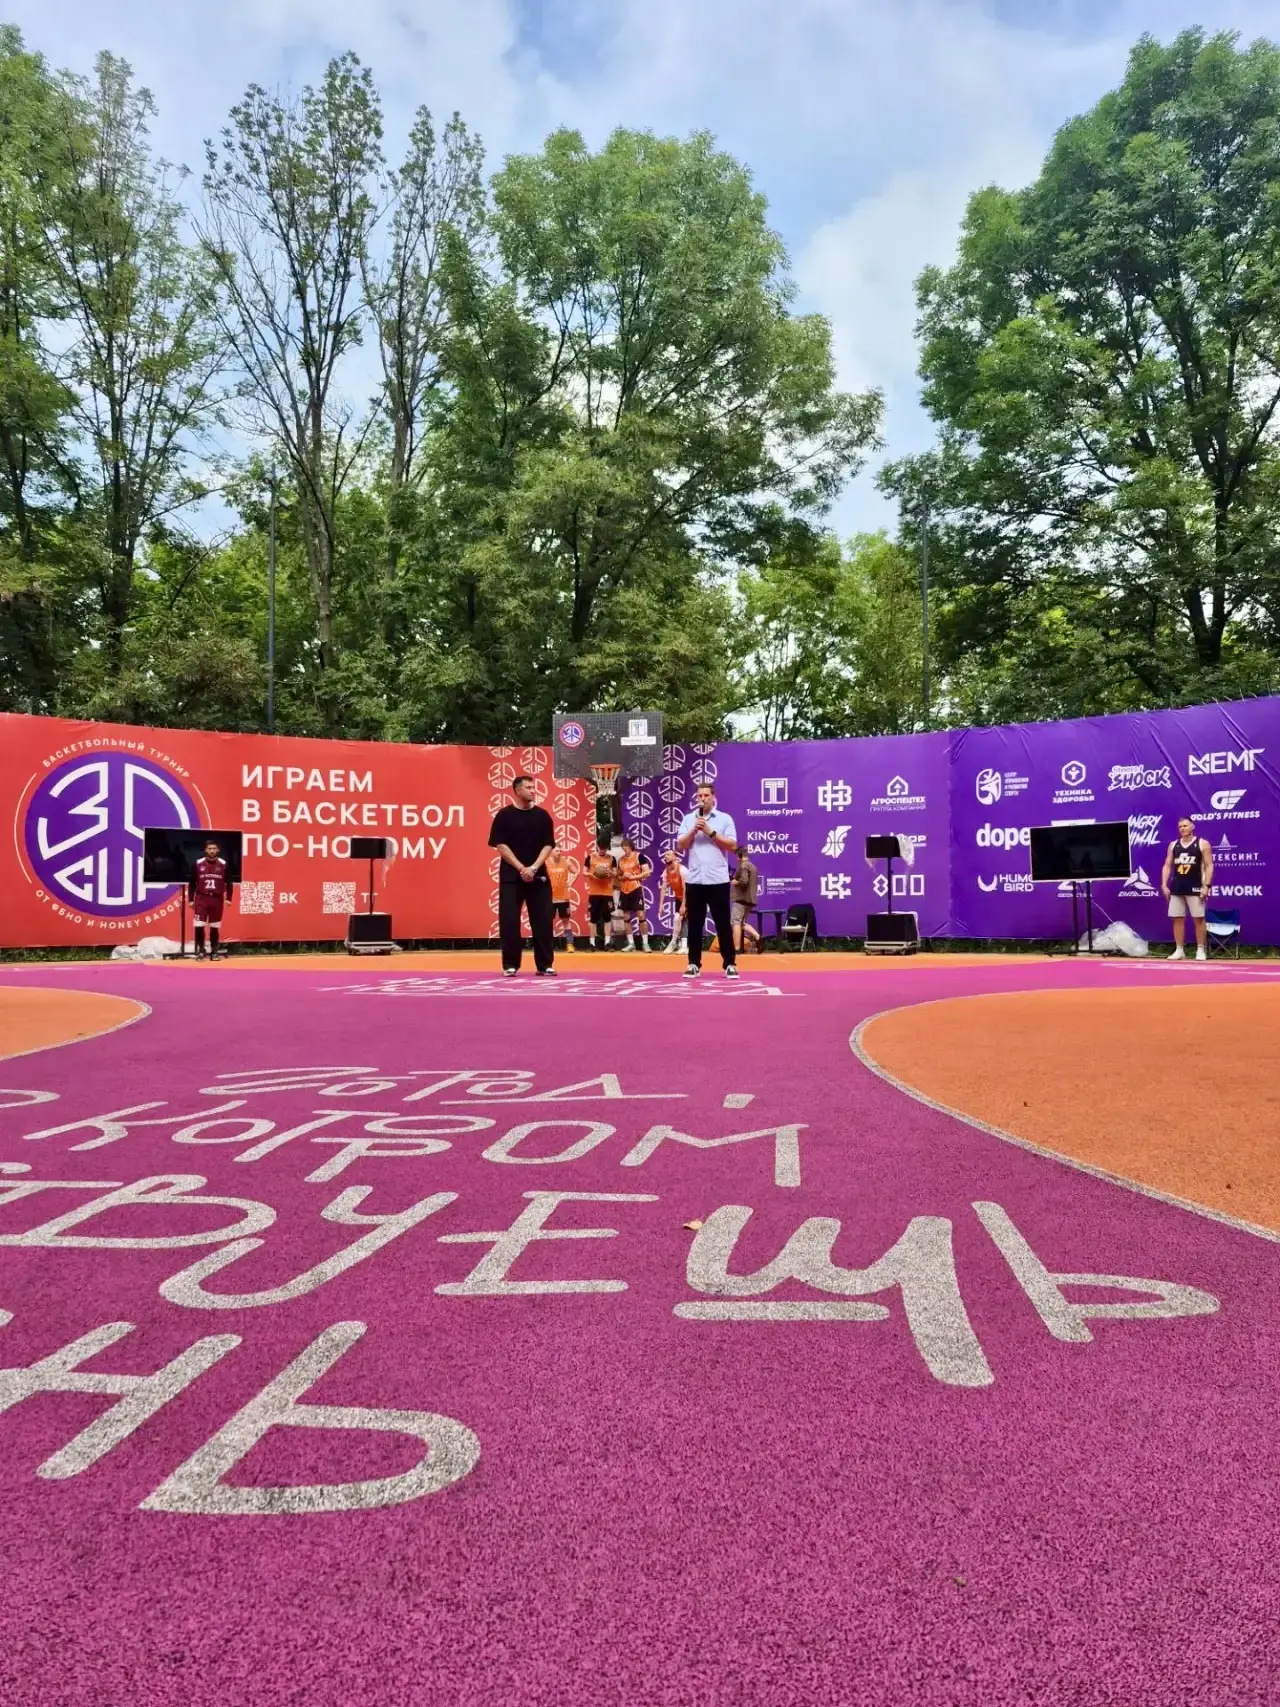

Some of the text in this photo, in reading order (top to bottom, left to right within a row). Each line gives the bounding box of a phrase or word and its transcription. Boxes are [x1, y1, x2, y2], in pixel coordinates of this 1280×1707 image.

[42, 738, 190, 778] БАСКЕТБОЛЬНЫЙ ТУРНИР
[241, 764, 373, 793] ИГРАЕМ
[1110, 767, 1169, 788] SHOCK
[1052, 796, 1095, 804] ЗДОРОВЬЯ
[242, 799, 465, 827] В БАСКЕТБОЛ
[1190, 810, 1260, 822] GOLD'S FITNESS
[747, 831, 777, 841] KING
[242, 833, 447, 859] ПО-НООМУ
[1177, 864, 1191, 875] 47
[205, 880, 216, 889] 21
[1003, 883, 1033, 892] BIRD
[279, 892, 298, 904] ВК
[36, 889, 50, 902] ОТ
[51, 904, 82, 923] ФБНО
[86, 918, 94, 927] И
[100, 919, 140, 929] HONEY
